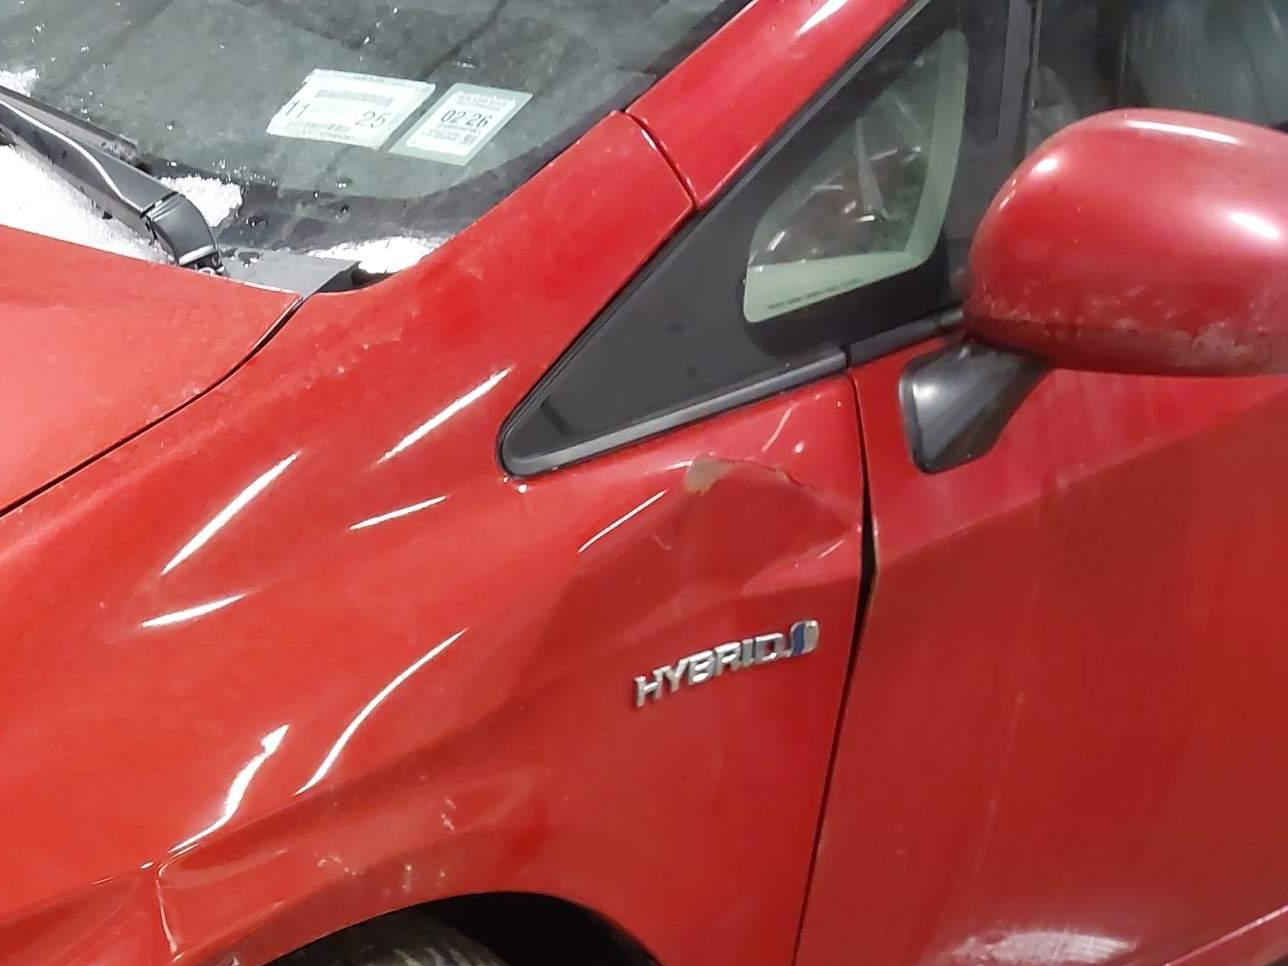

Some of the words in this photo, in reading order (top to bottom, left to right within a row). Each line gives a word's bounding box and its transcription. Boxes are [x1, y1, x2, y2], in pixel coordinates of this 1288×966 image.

[354, 110, 387, 128] 25
[440, 108, 466, 125] 02
[466, 111, 492, 128] 26
[634, 632, 786, 707] HYBRID
